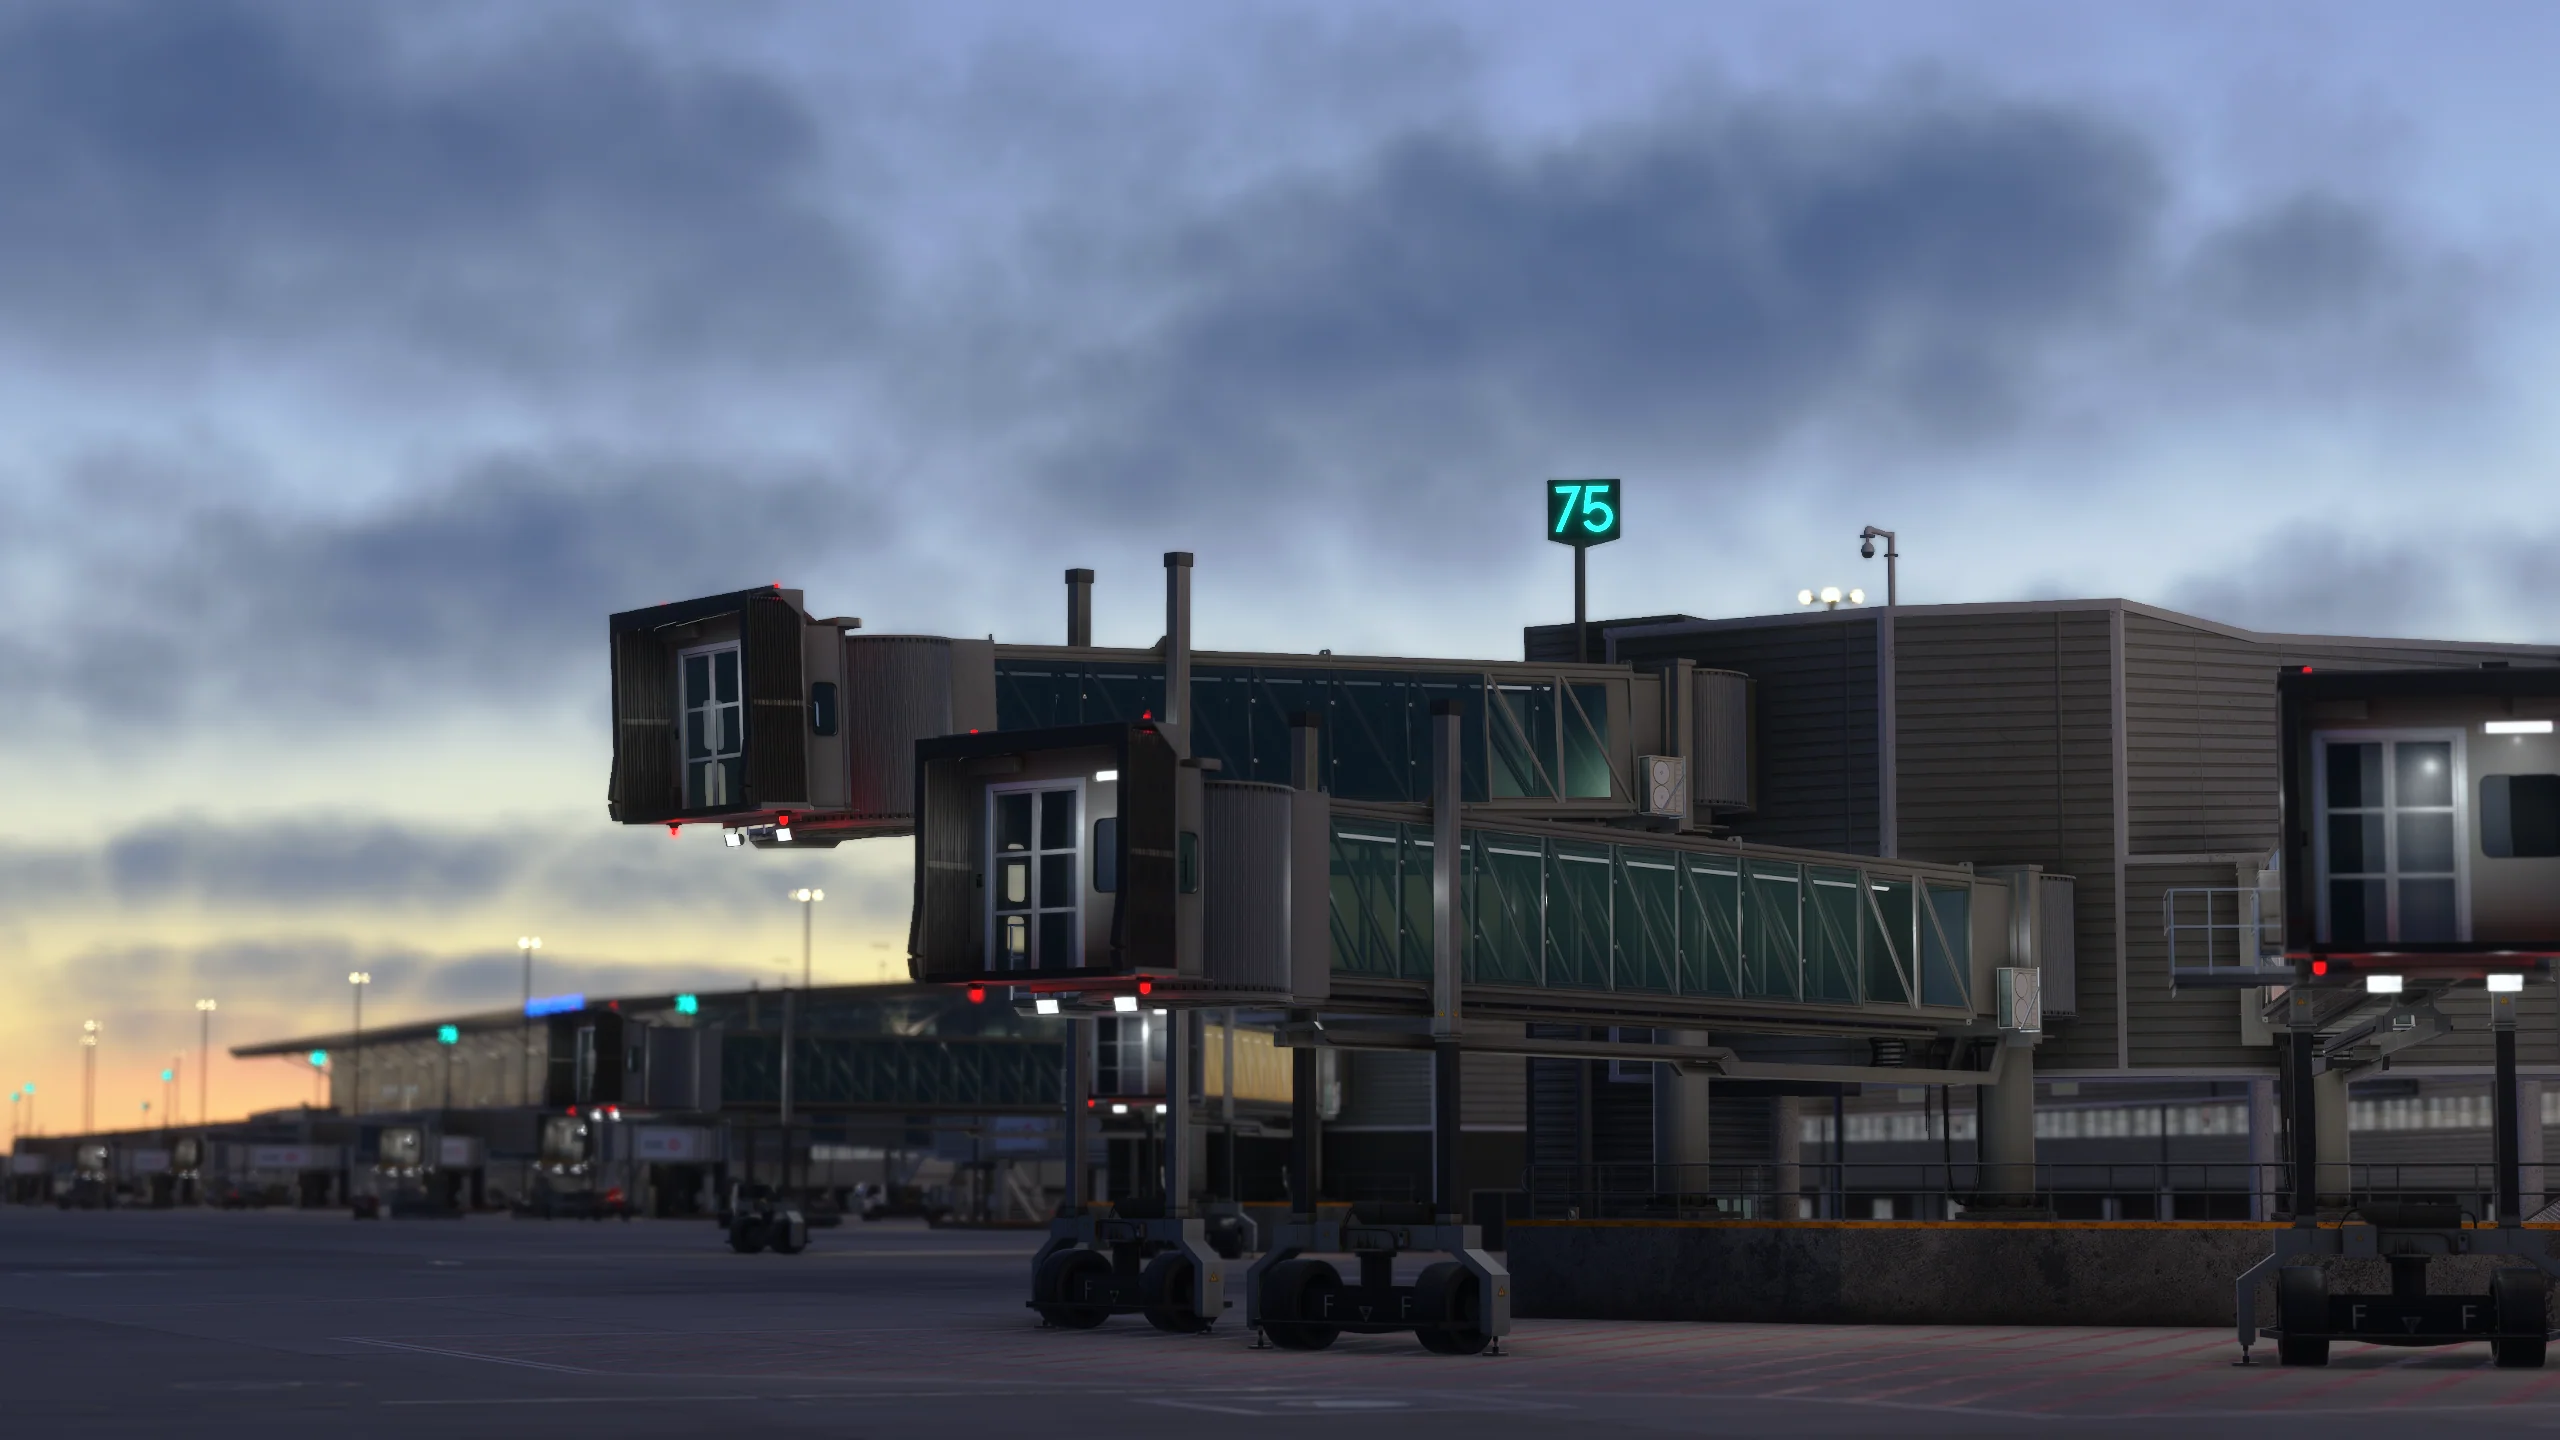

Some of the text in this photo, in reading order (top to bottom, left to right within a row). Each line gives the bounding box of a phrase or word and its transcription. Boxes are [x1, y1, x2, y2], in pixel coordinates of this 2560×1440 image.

[1555, 485, 1614, 533] 75
[1085, 1279, 1093, 1301] F
[1324, 1294, 1335, 1318] F
[1402, 1296, 1412, 1320] F
[2352, 1304, 2367, 1330] F
[2462, 1304, 2477, 1330] F
